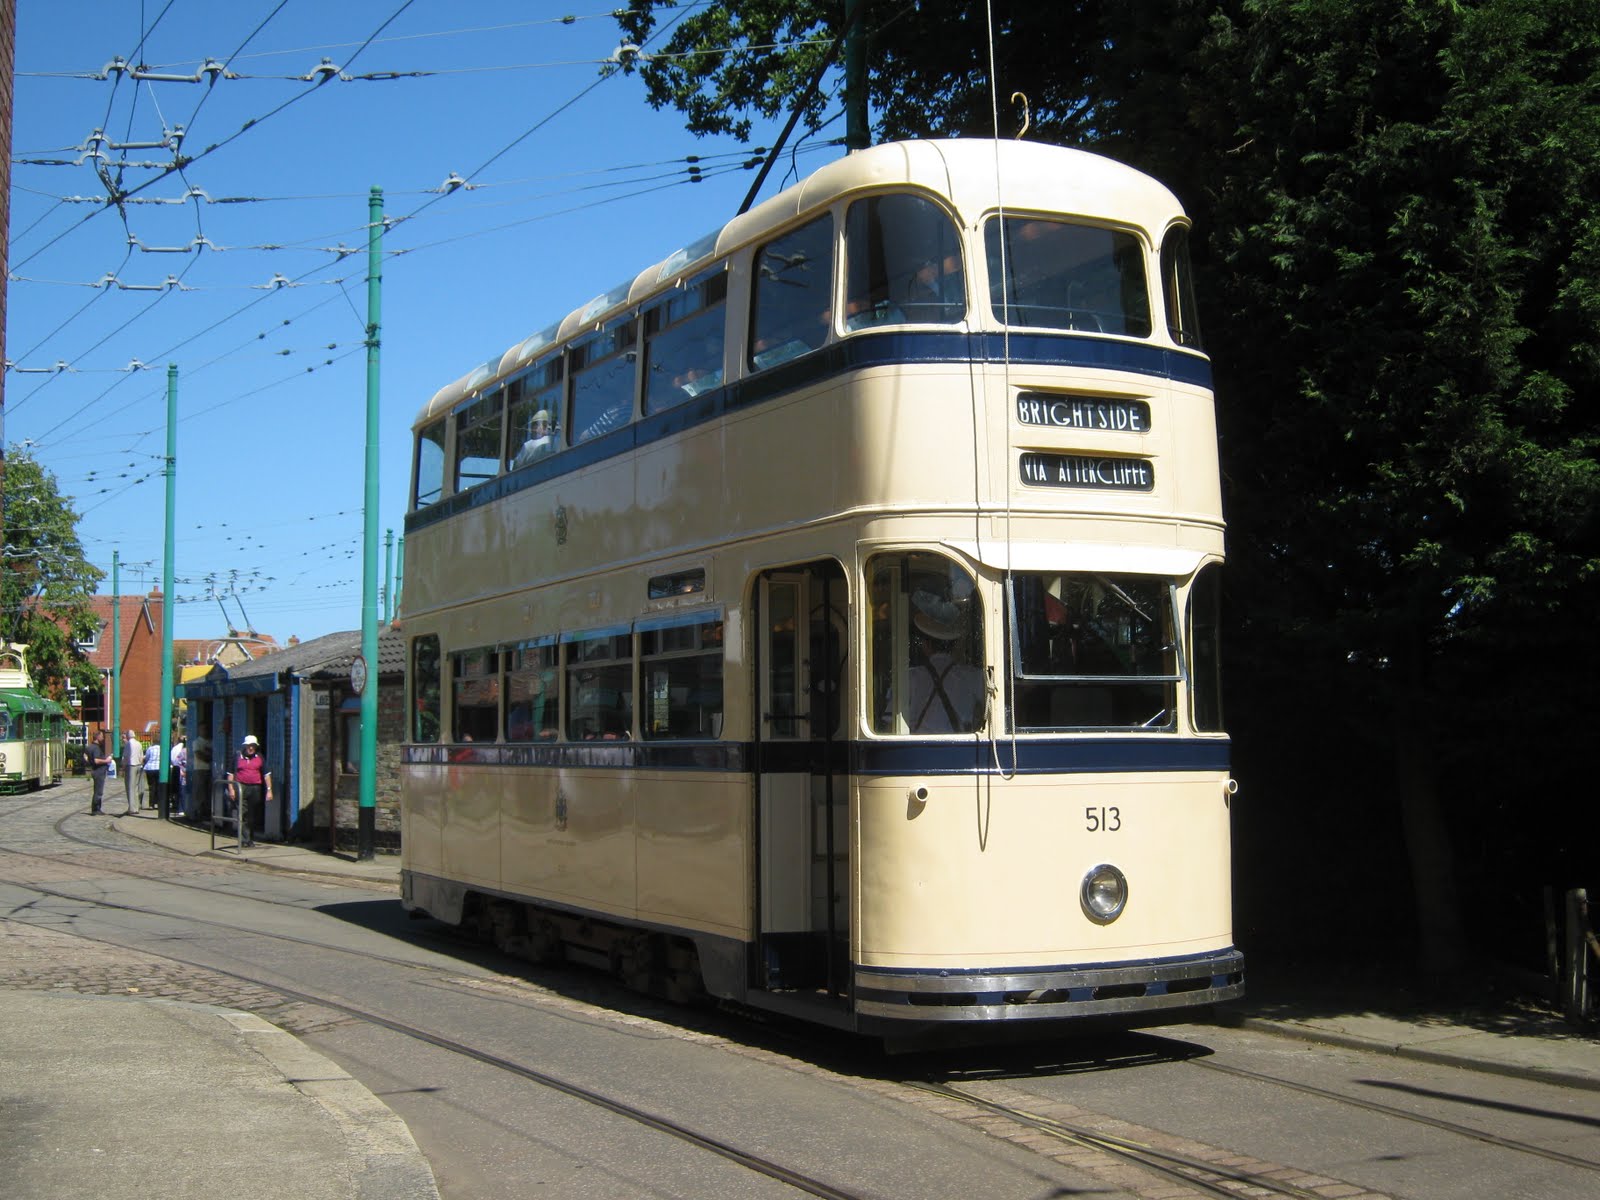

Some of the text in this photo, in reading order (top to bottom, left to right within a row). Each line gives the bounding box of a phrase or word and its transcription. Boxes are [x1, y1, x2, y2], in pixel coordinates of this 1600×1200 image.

[1018, 399, 1141, 431] BRIGHTSIDE
[1024, 456, 1147, 485] VIA ATTERCLIFFE
[1085, 806, 1121, 832] 513
